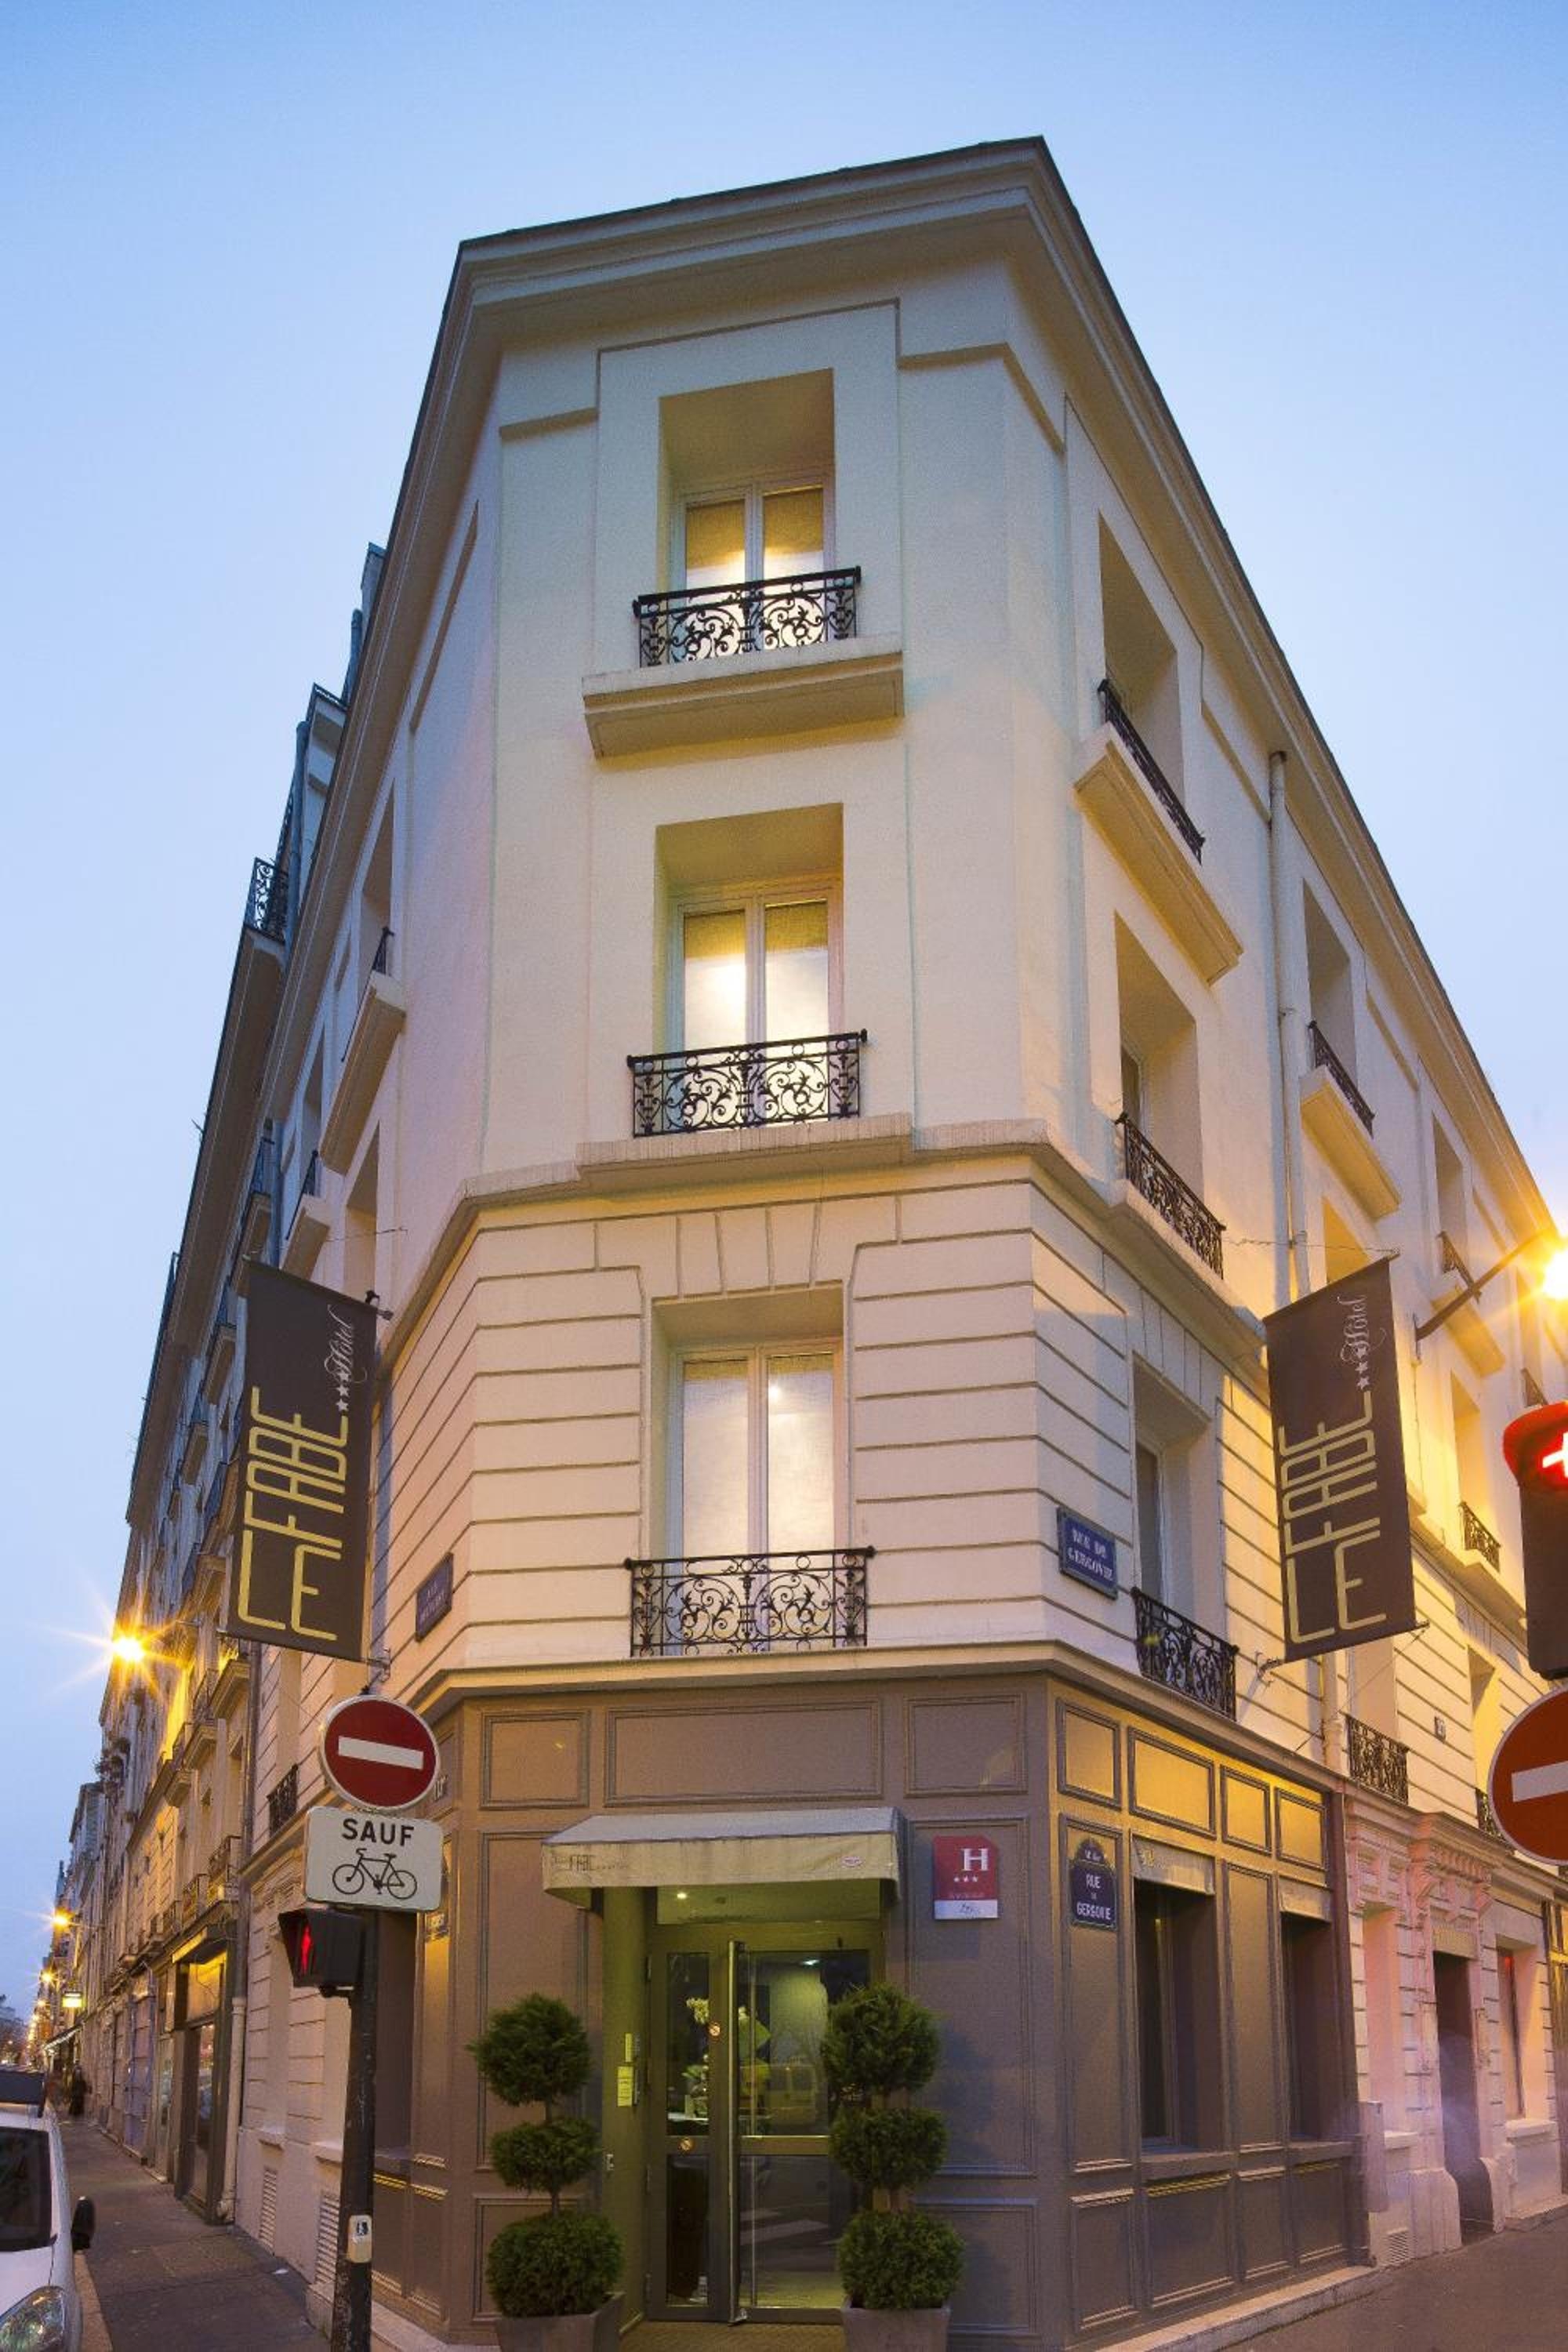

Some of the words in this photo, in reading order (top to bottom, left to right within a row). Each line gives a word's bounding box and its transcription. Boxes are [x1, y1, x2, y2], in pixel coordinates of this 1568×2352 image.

[245, 1385, 349, 1549] FABE
[1278, 1390, 1381, 1556] FABE
[238, 1530, 342, 1641] LE
[1287, 1530, 1387, 1643] LE
[342, 1817, 415, 1847] SAUF
[960, 1847, 989, 1871] H
[1085, 1873, 1101, 1889] RUE
